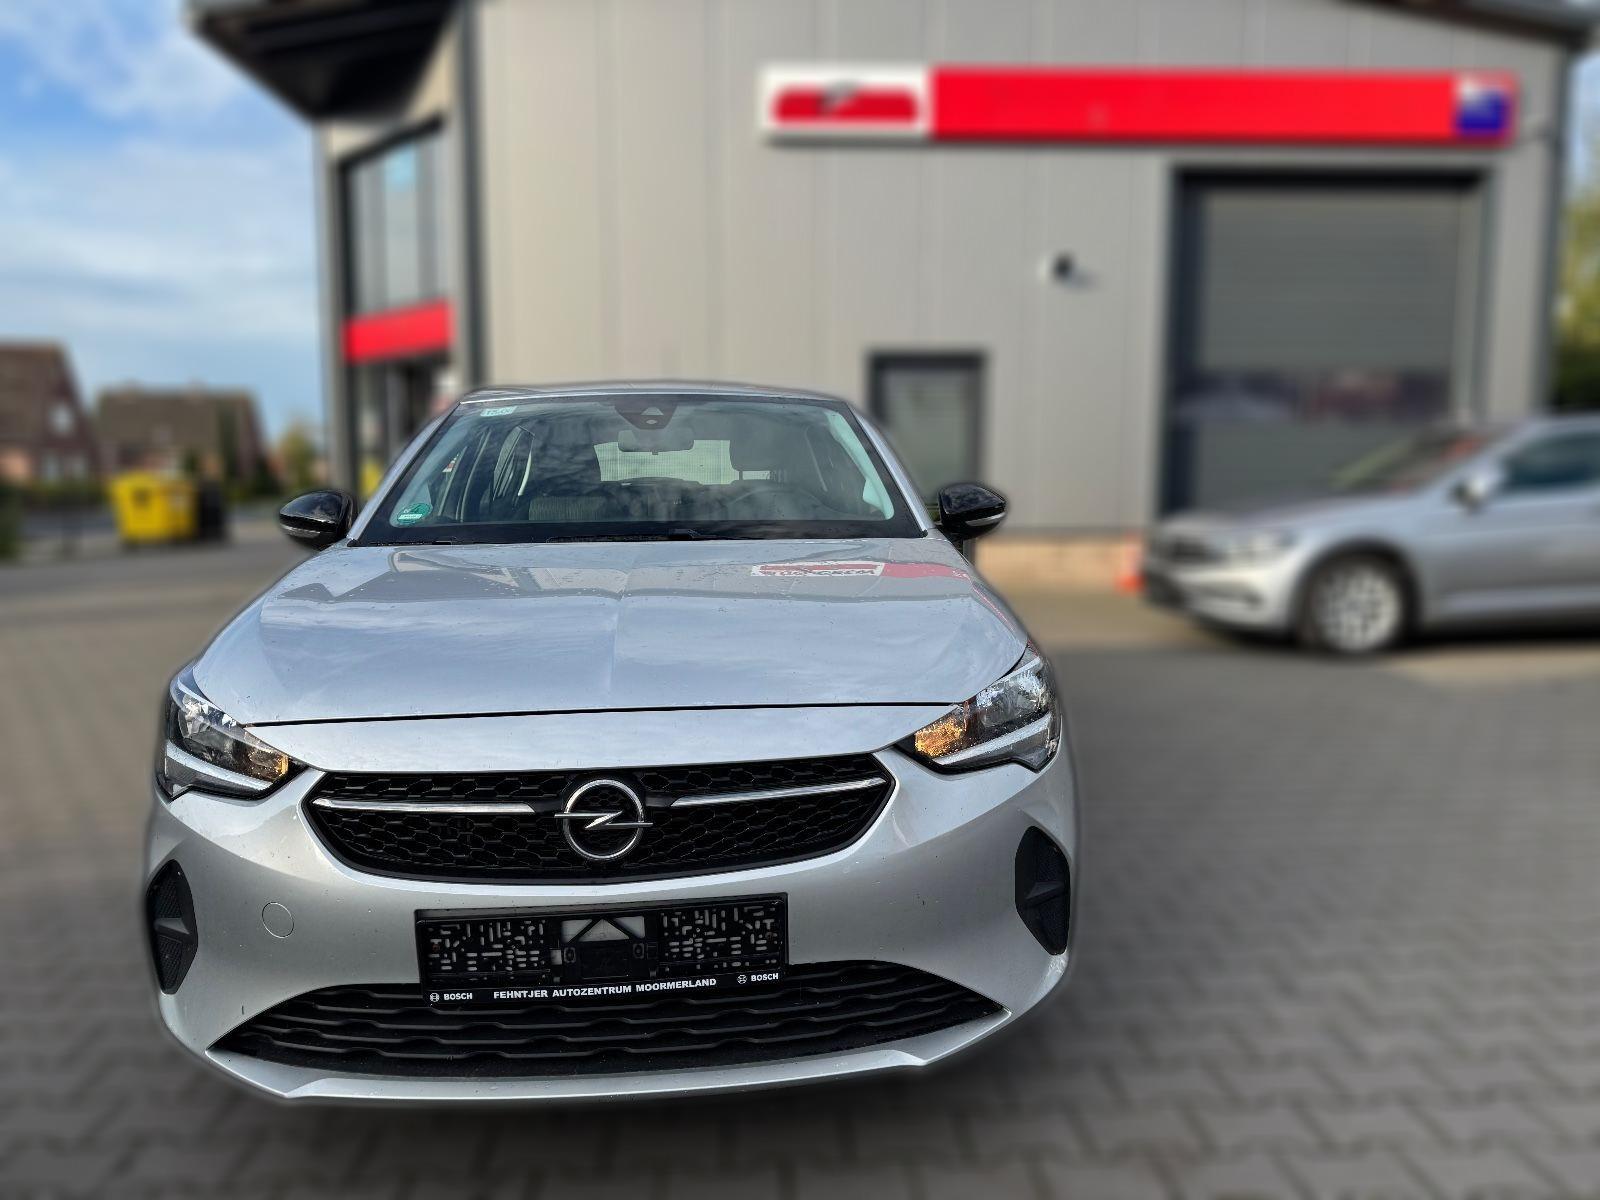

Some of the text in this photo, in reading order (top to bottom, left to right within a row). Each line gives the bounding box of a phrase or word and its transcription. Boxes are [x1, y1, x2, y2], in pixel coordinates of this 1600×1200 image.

[751, 973, 779, 982] BOSCH
[493, 979, 717, 999] FEHNTJER AUTOZENTRUM MOORMERLAND
[443, 992, 473, 1001] BOSCH
